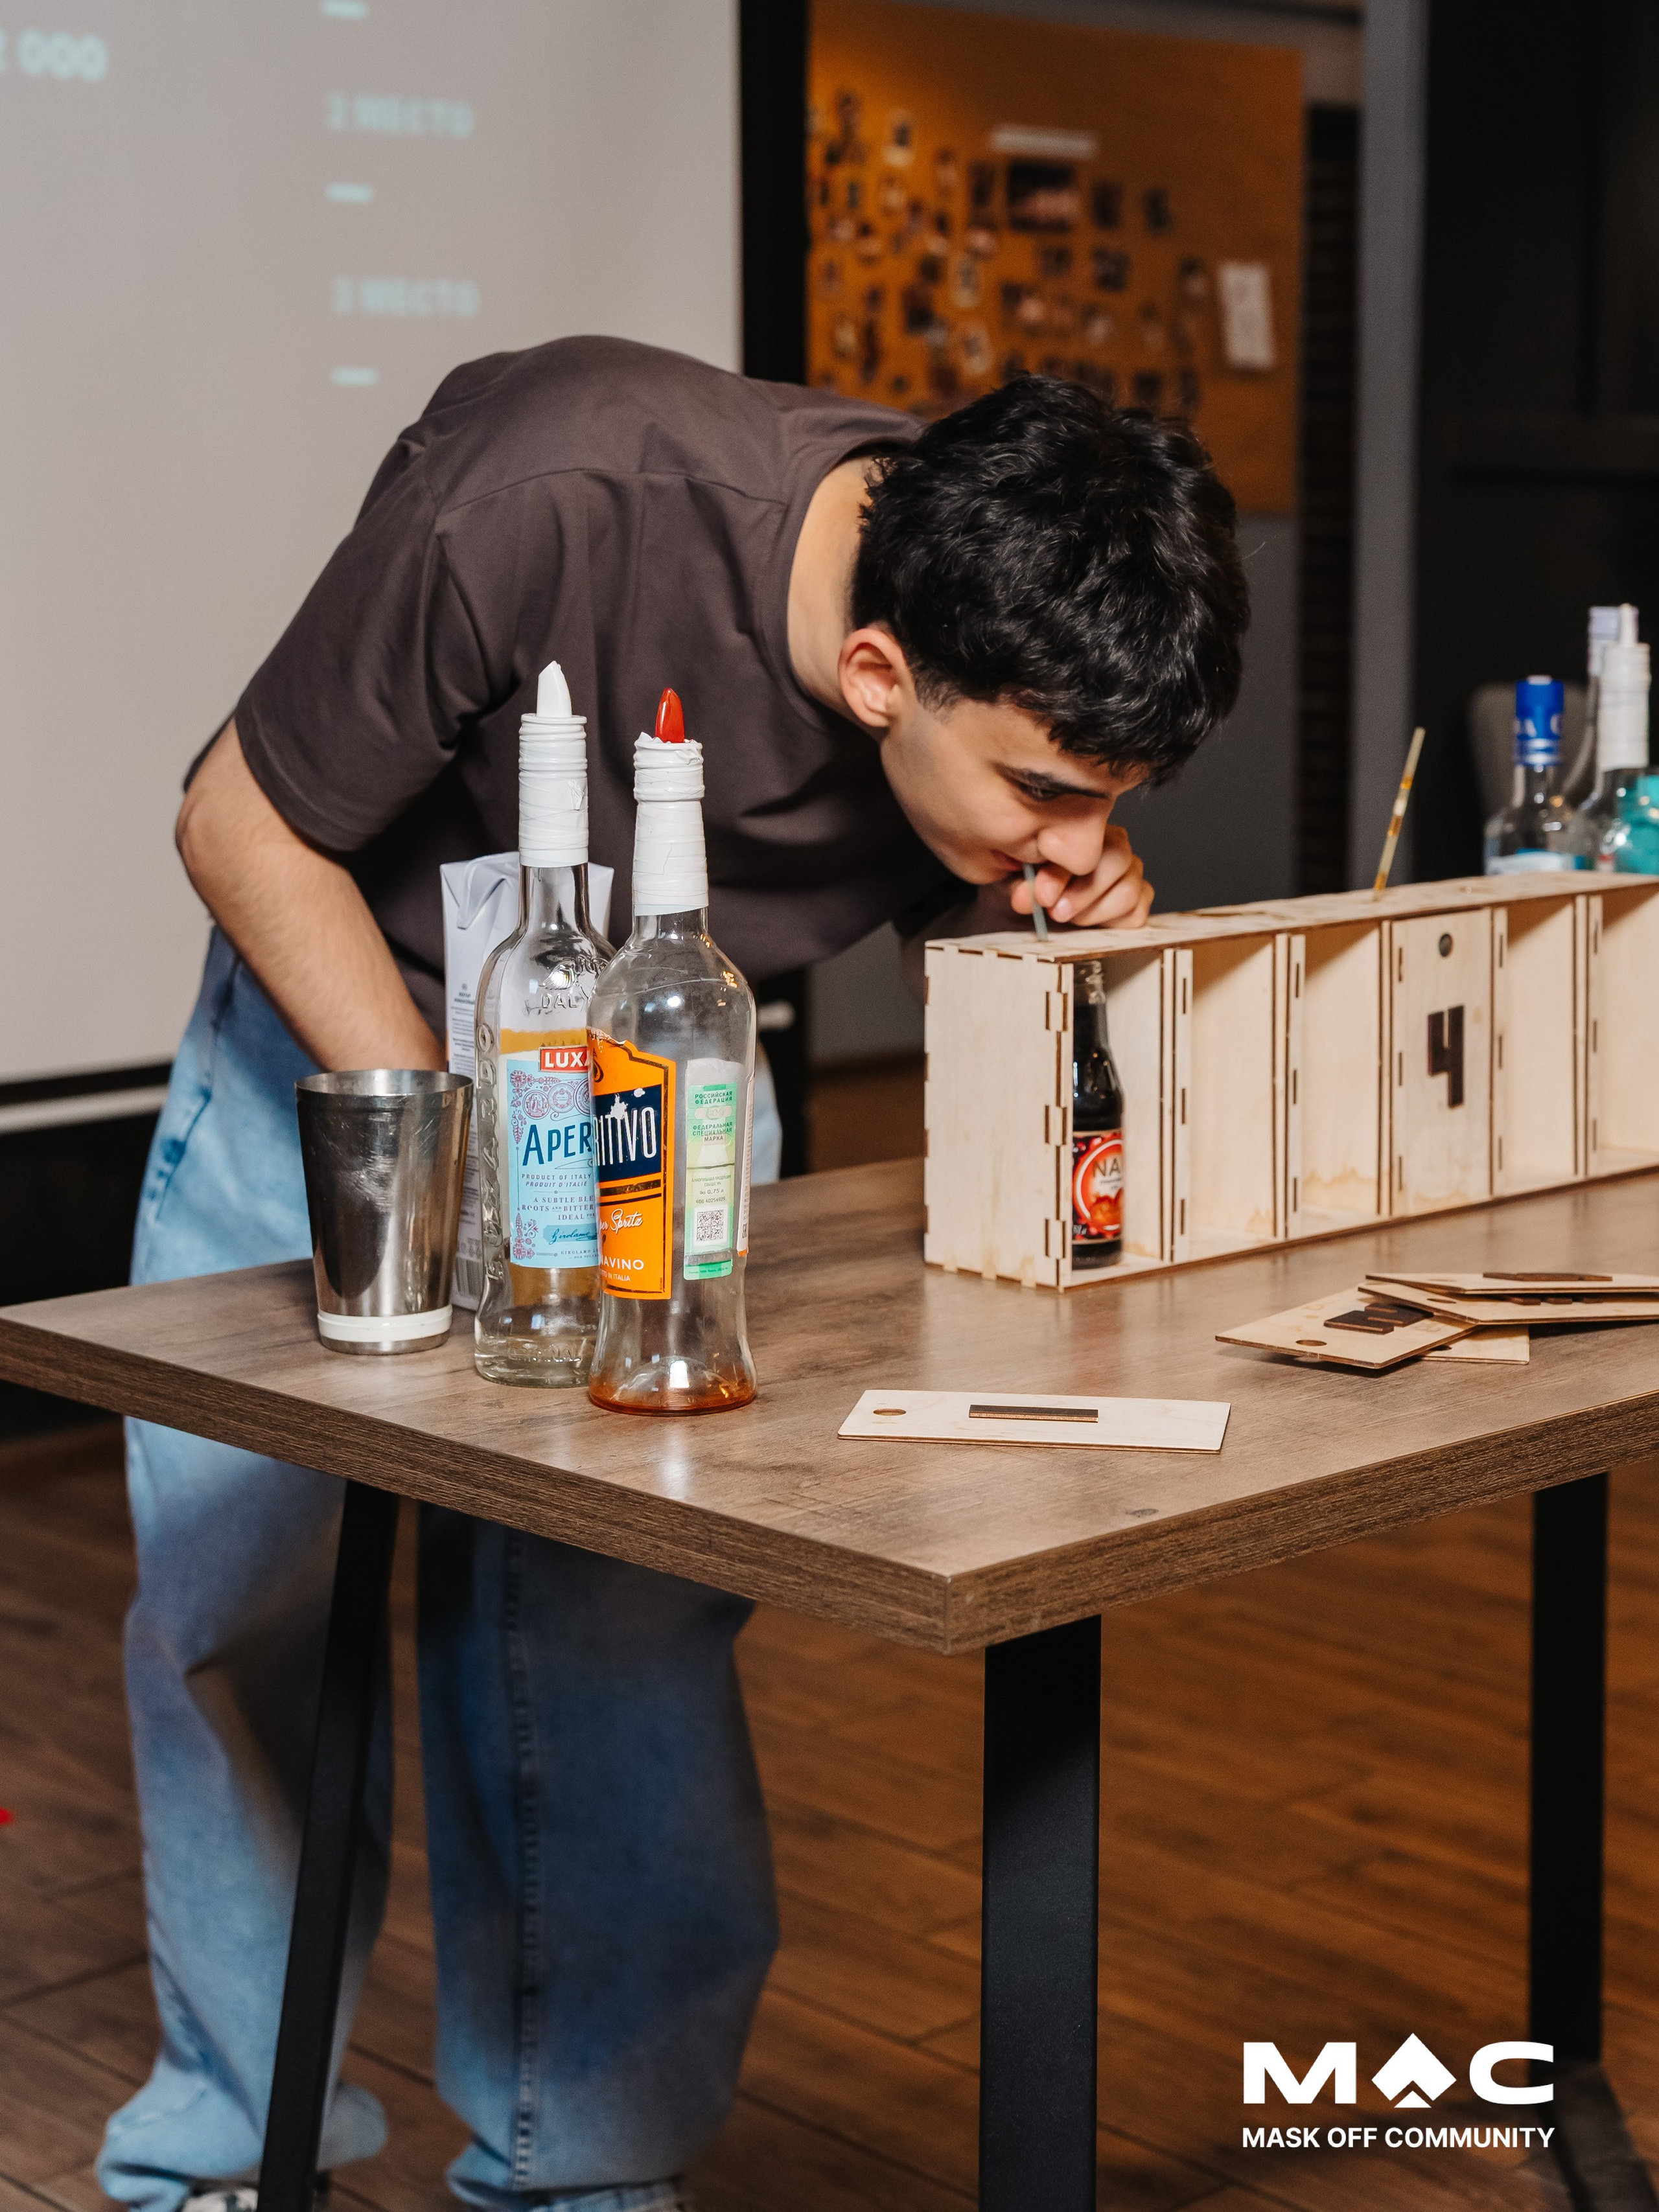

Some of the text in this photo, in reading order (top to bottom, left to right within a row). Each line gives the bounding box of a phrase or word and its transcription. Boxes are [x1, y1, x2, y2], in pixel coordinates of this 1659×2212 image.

[1428, 1004, 1465, 1109] 4
[695, 1090, 732, 1099] РОССИЙСКАЯ
[695, 1096, 732, 1105] ФЕДЕРАЦИЯ
[693, 1122, 733, 1130] ФЕДЕРАЛЬНАЯ
[692, 1127, 732, 1136] СПЕЦИАЛЬНАЯ
[610, 1208, 643, 1234] Spritz
